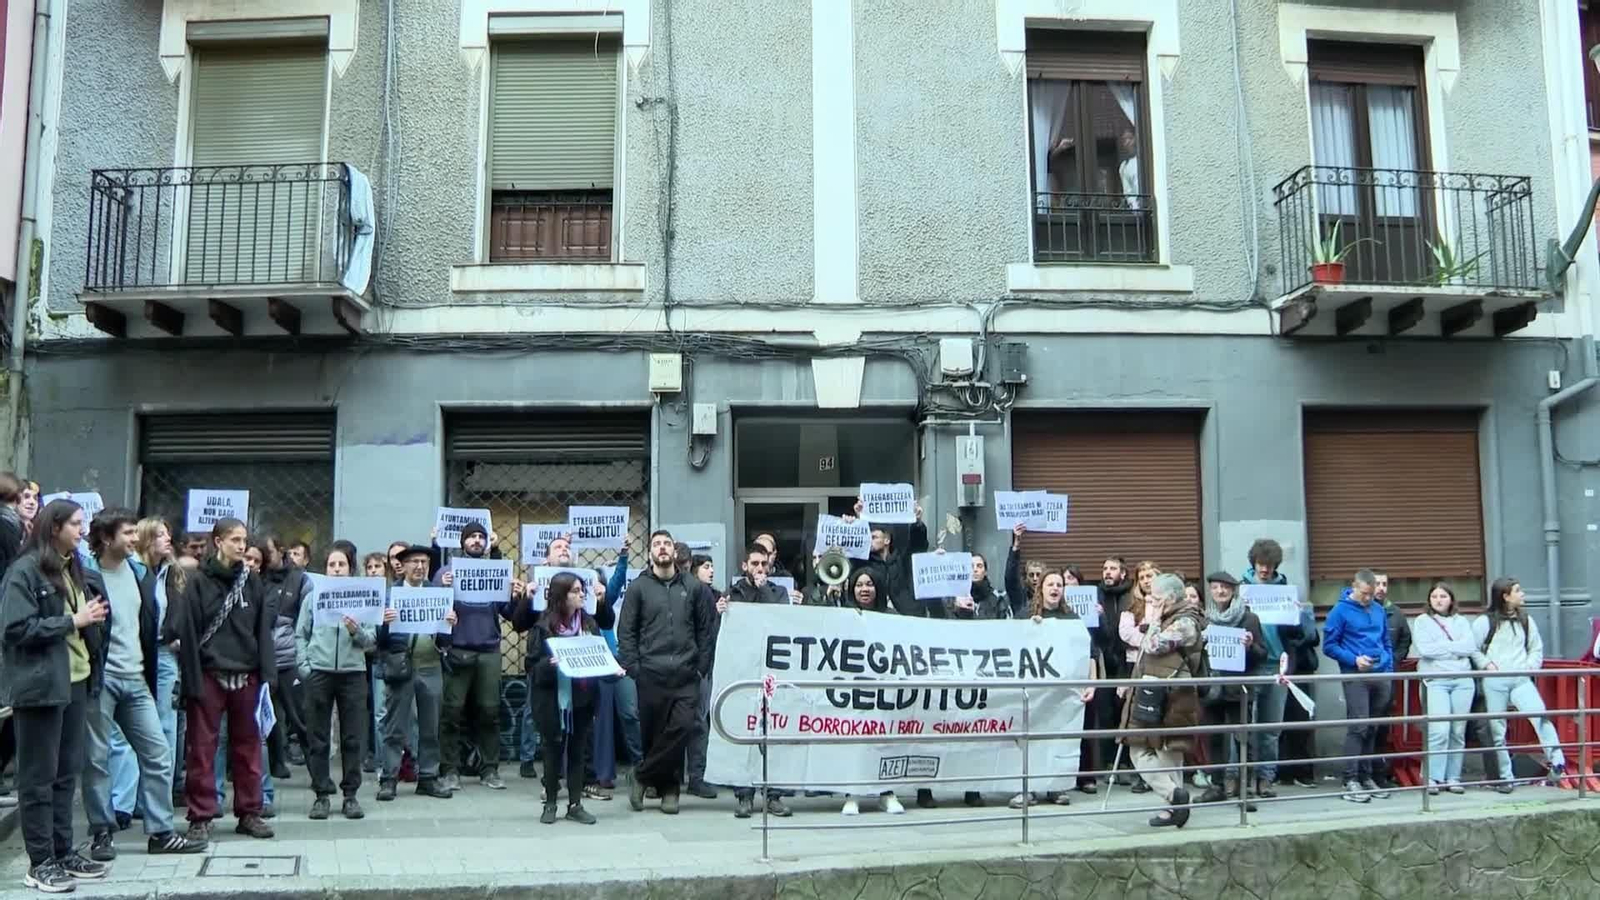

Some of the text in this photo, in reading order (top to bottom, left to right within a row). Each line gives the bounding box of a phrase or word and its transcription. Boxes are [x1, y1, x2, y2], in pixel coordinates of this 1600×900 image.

[820, 457, 833, 470] 94
[868, 501, 908, 513] GELDITU!
[573, 514, 625, 526] ETXEGABETZEAK
[578, 524, 620, 538] GELDITU!
[825, 534, 863, 548] GELDITU!
[455, 568, 509, 578] ETXEGABETZEAK
[460, 578, 503, 591] GELDITU!
[327, 599, 363, 609] DESAHUCIO
[400, 607, 446, 622] GELDITU!
[566, 654, 608, 668] GELDITU!
[766, 635, 1060, 679] ETXEGABETZEAK
[825, 676, 988, 710] GELDITU!
[898, 719, 924, 734] BATU
[882, 759, 905, 776] AZET
